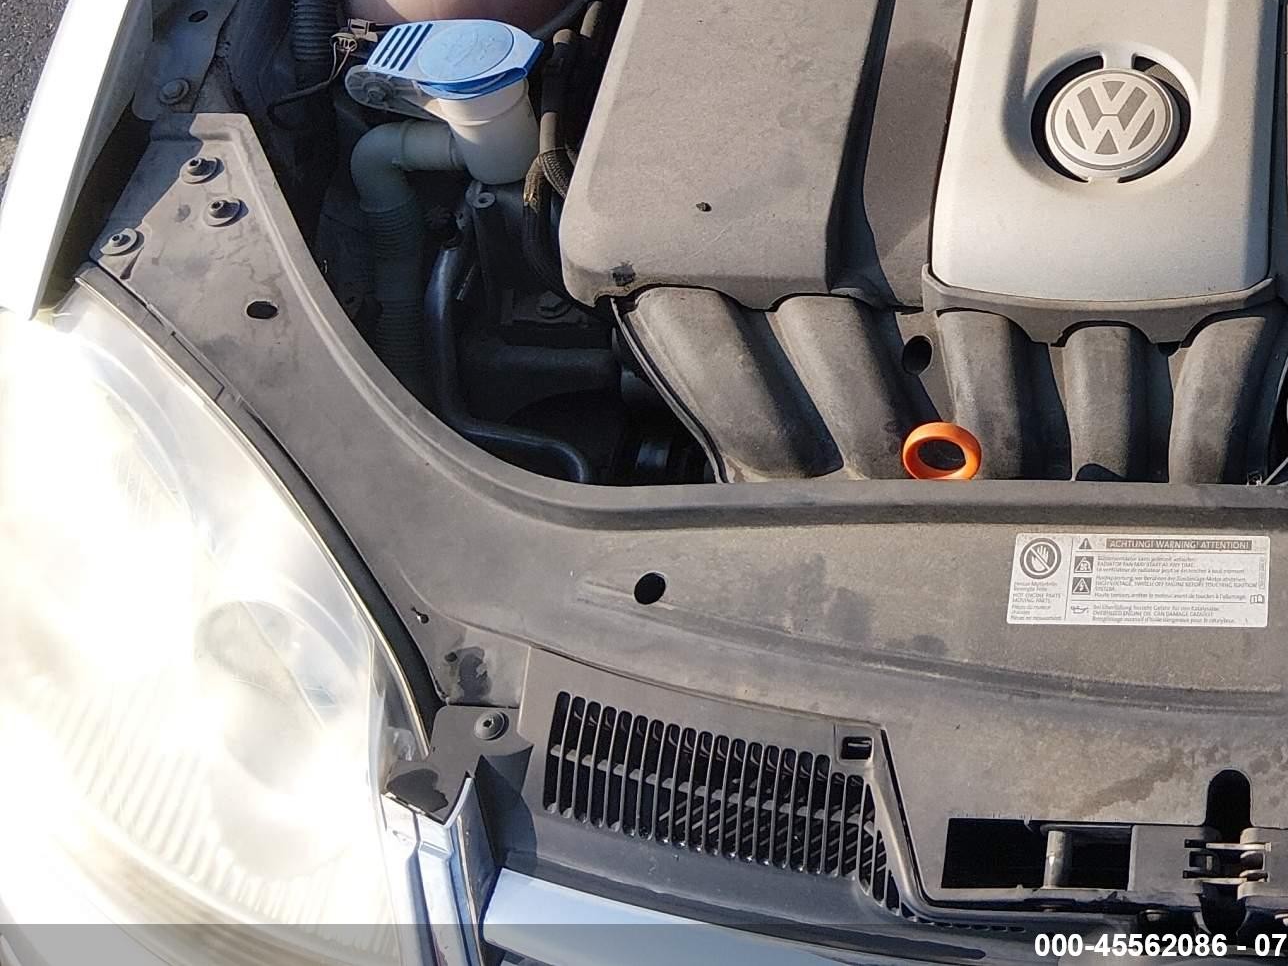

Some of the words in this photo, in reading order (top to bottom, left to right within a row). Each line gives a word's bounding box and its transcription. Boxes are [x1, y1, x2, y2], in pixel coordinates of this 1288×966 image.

[1109, 539, 1154, 548] ACHTUNG!
[1156, 540, 1199, 549] WARNING!
[1200, 540, 1249, 549] ATTENTION!
